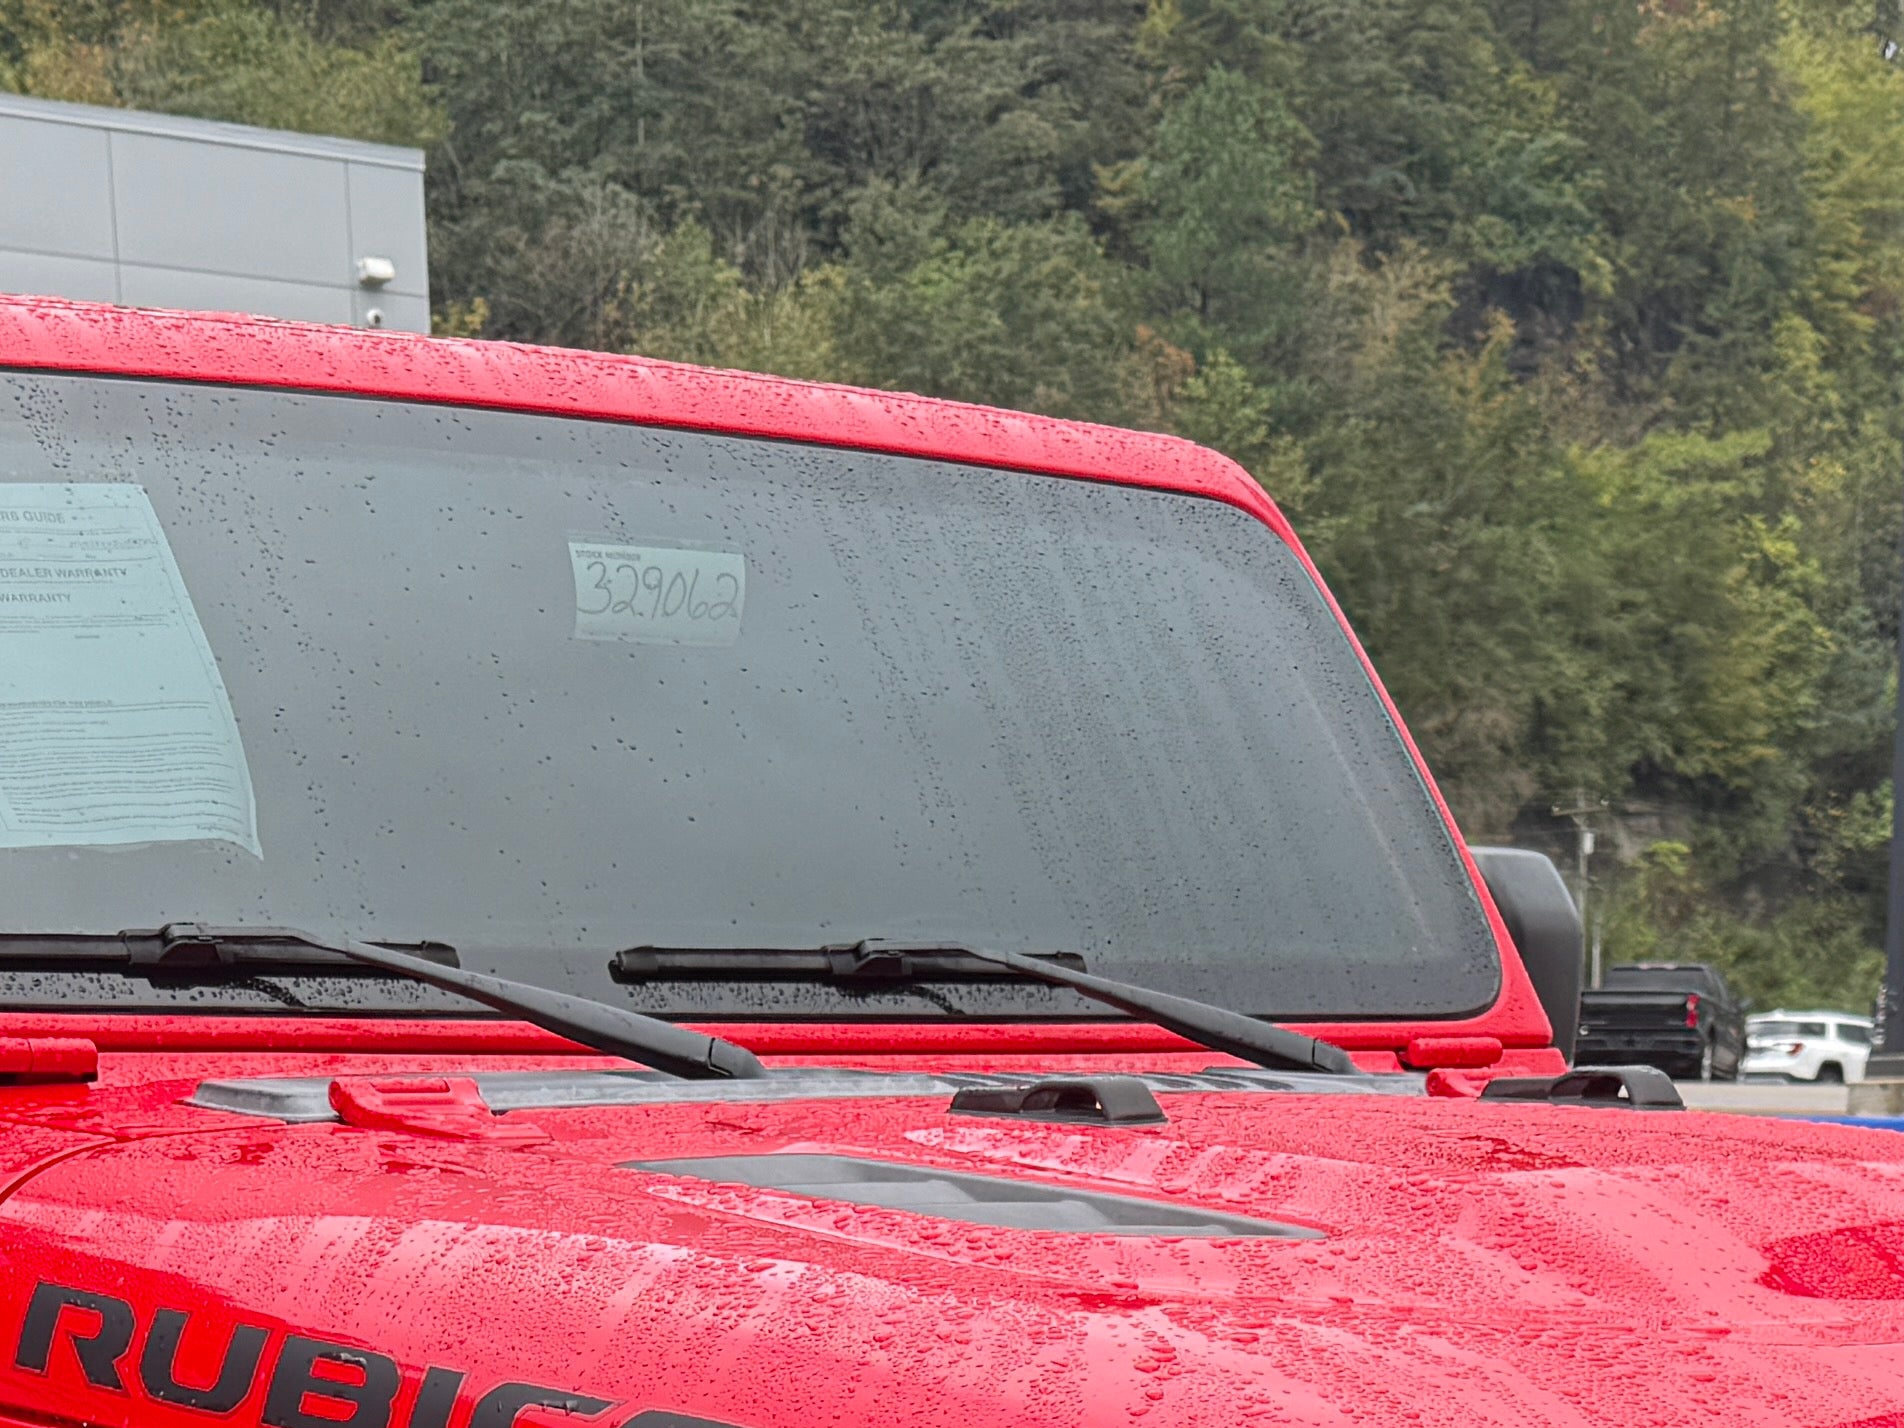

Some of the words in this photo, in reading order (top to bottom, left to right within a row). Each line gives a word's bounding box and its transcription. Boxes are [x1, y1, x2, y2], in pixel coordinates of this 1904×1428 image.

[23, 511, 66, 524] GUIDE
[0, 567, 53, 579] DEALER
[56, 568, 127, 580] WARRANTY
[576, 560, 739, 621] 329062
